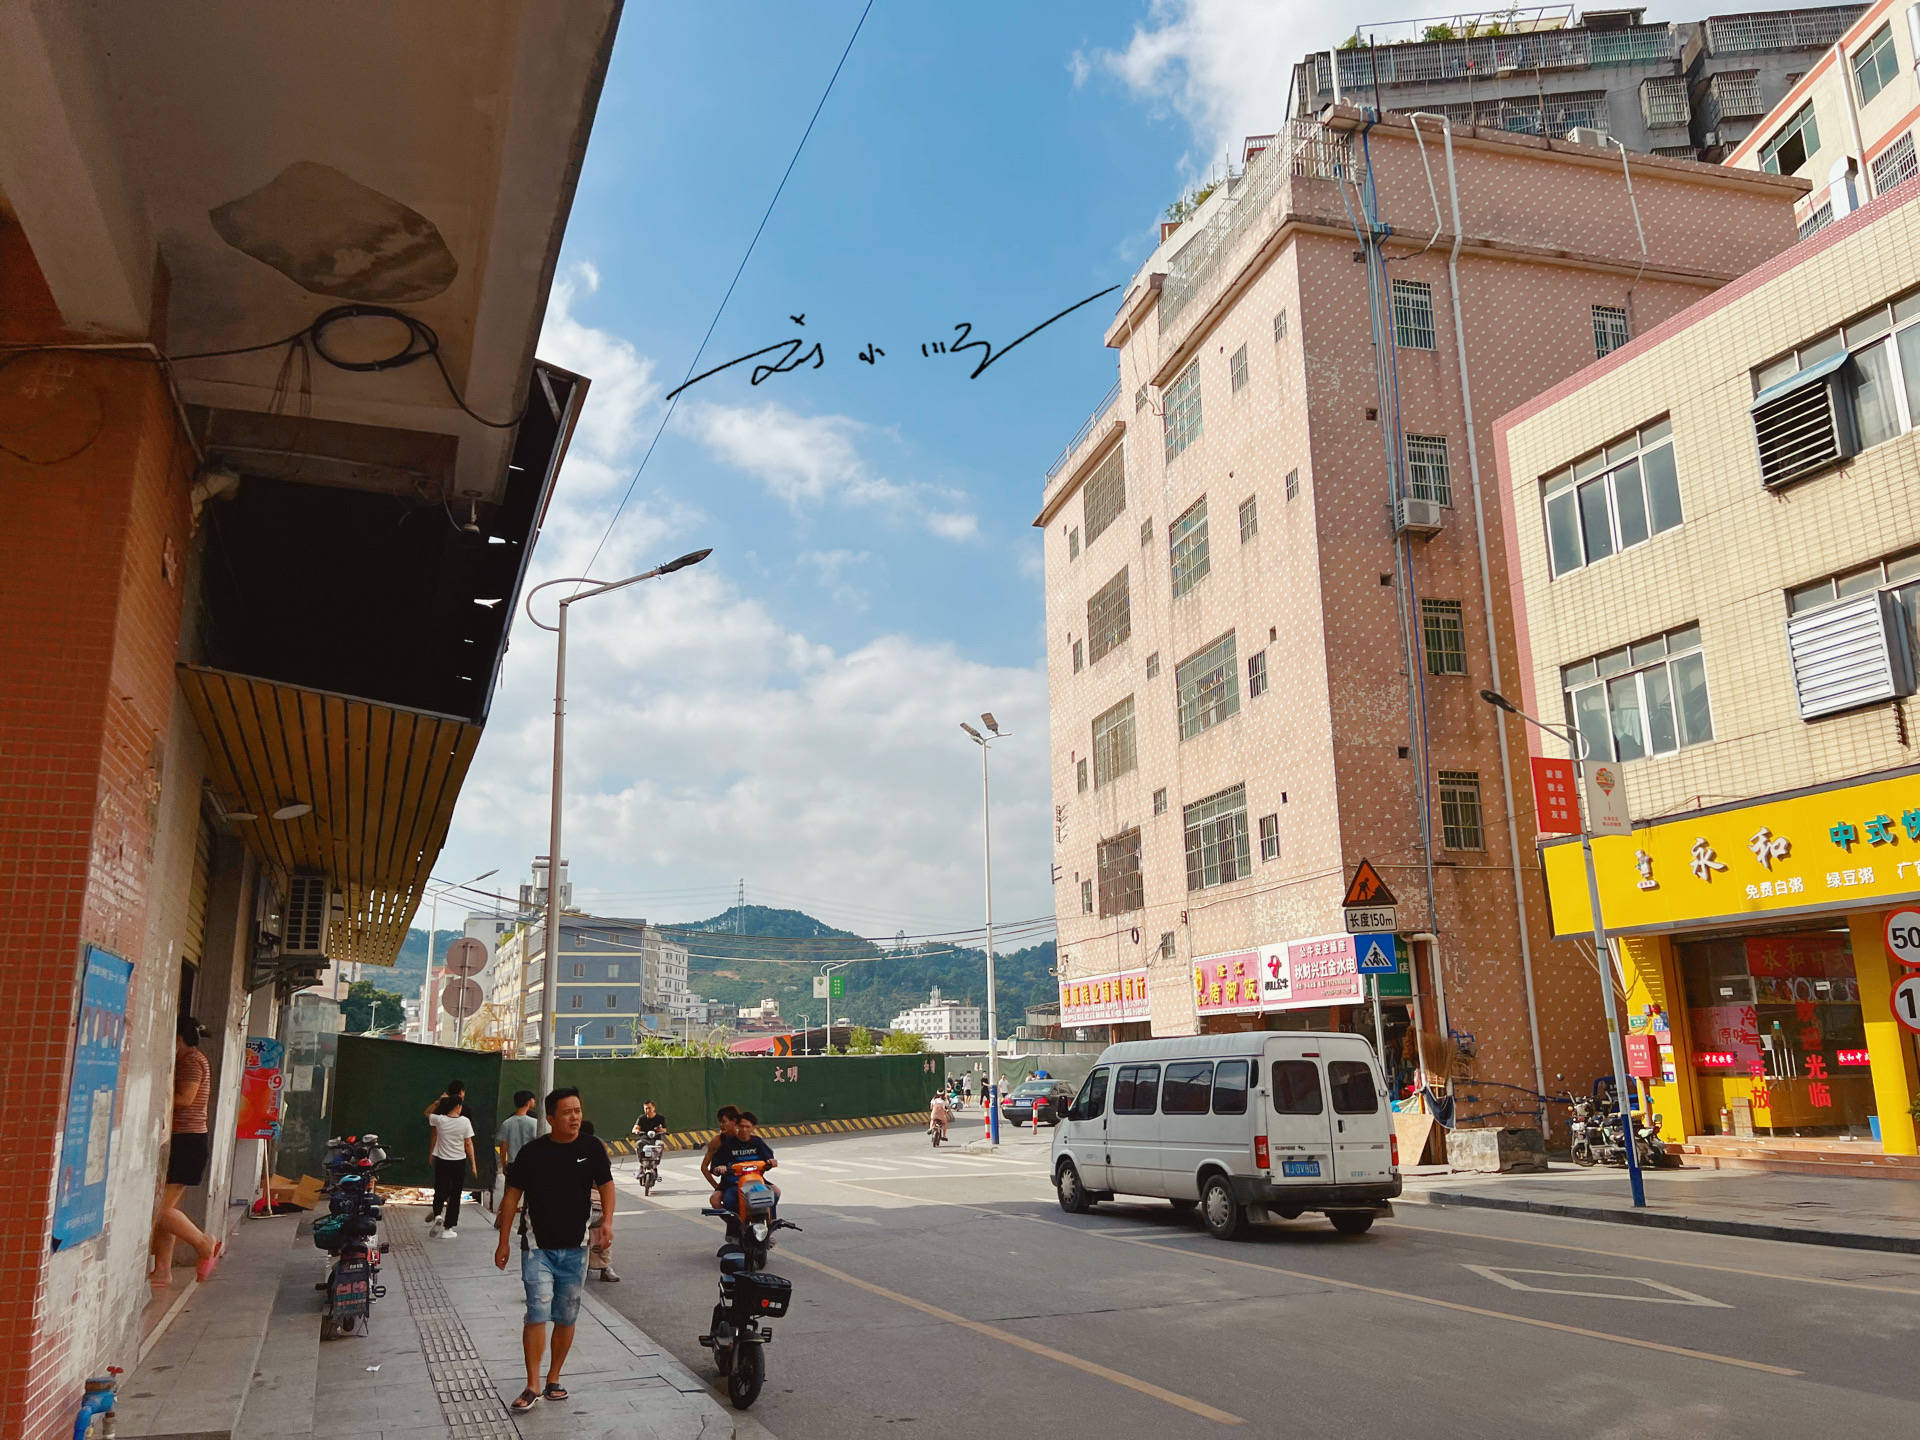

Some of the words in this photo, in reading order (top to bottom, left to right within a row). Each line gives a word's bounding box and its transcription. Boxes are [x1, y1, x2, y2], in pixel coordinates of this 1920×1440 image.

[1690, 826, 1792, 883] 永和
[1745, 876, 1804, 900] 免费白粥
[1826, 866, 1875, 888] 绿豆粥
[1349, 911, 1393, 928] 长度150m
[773, 1065, 798, 1082] 文明
[1739, 1005, 1773, 1109] 冷气开放
